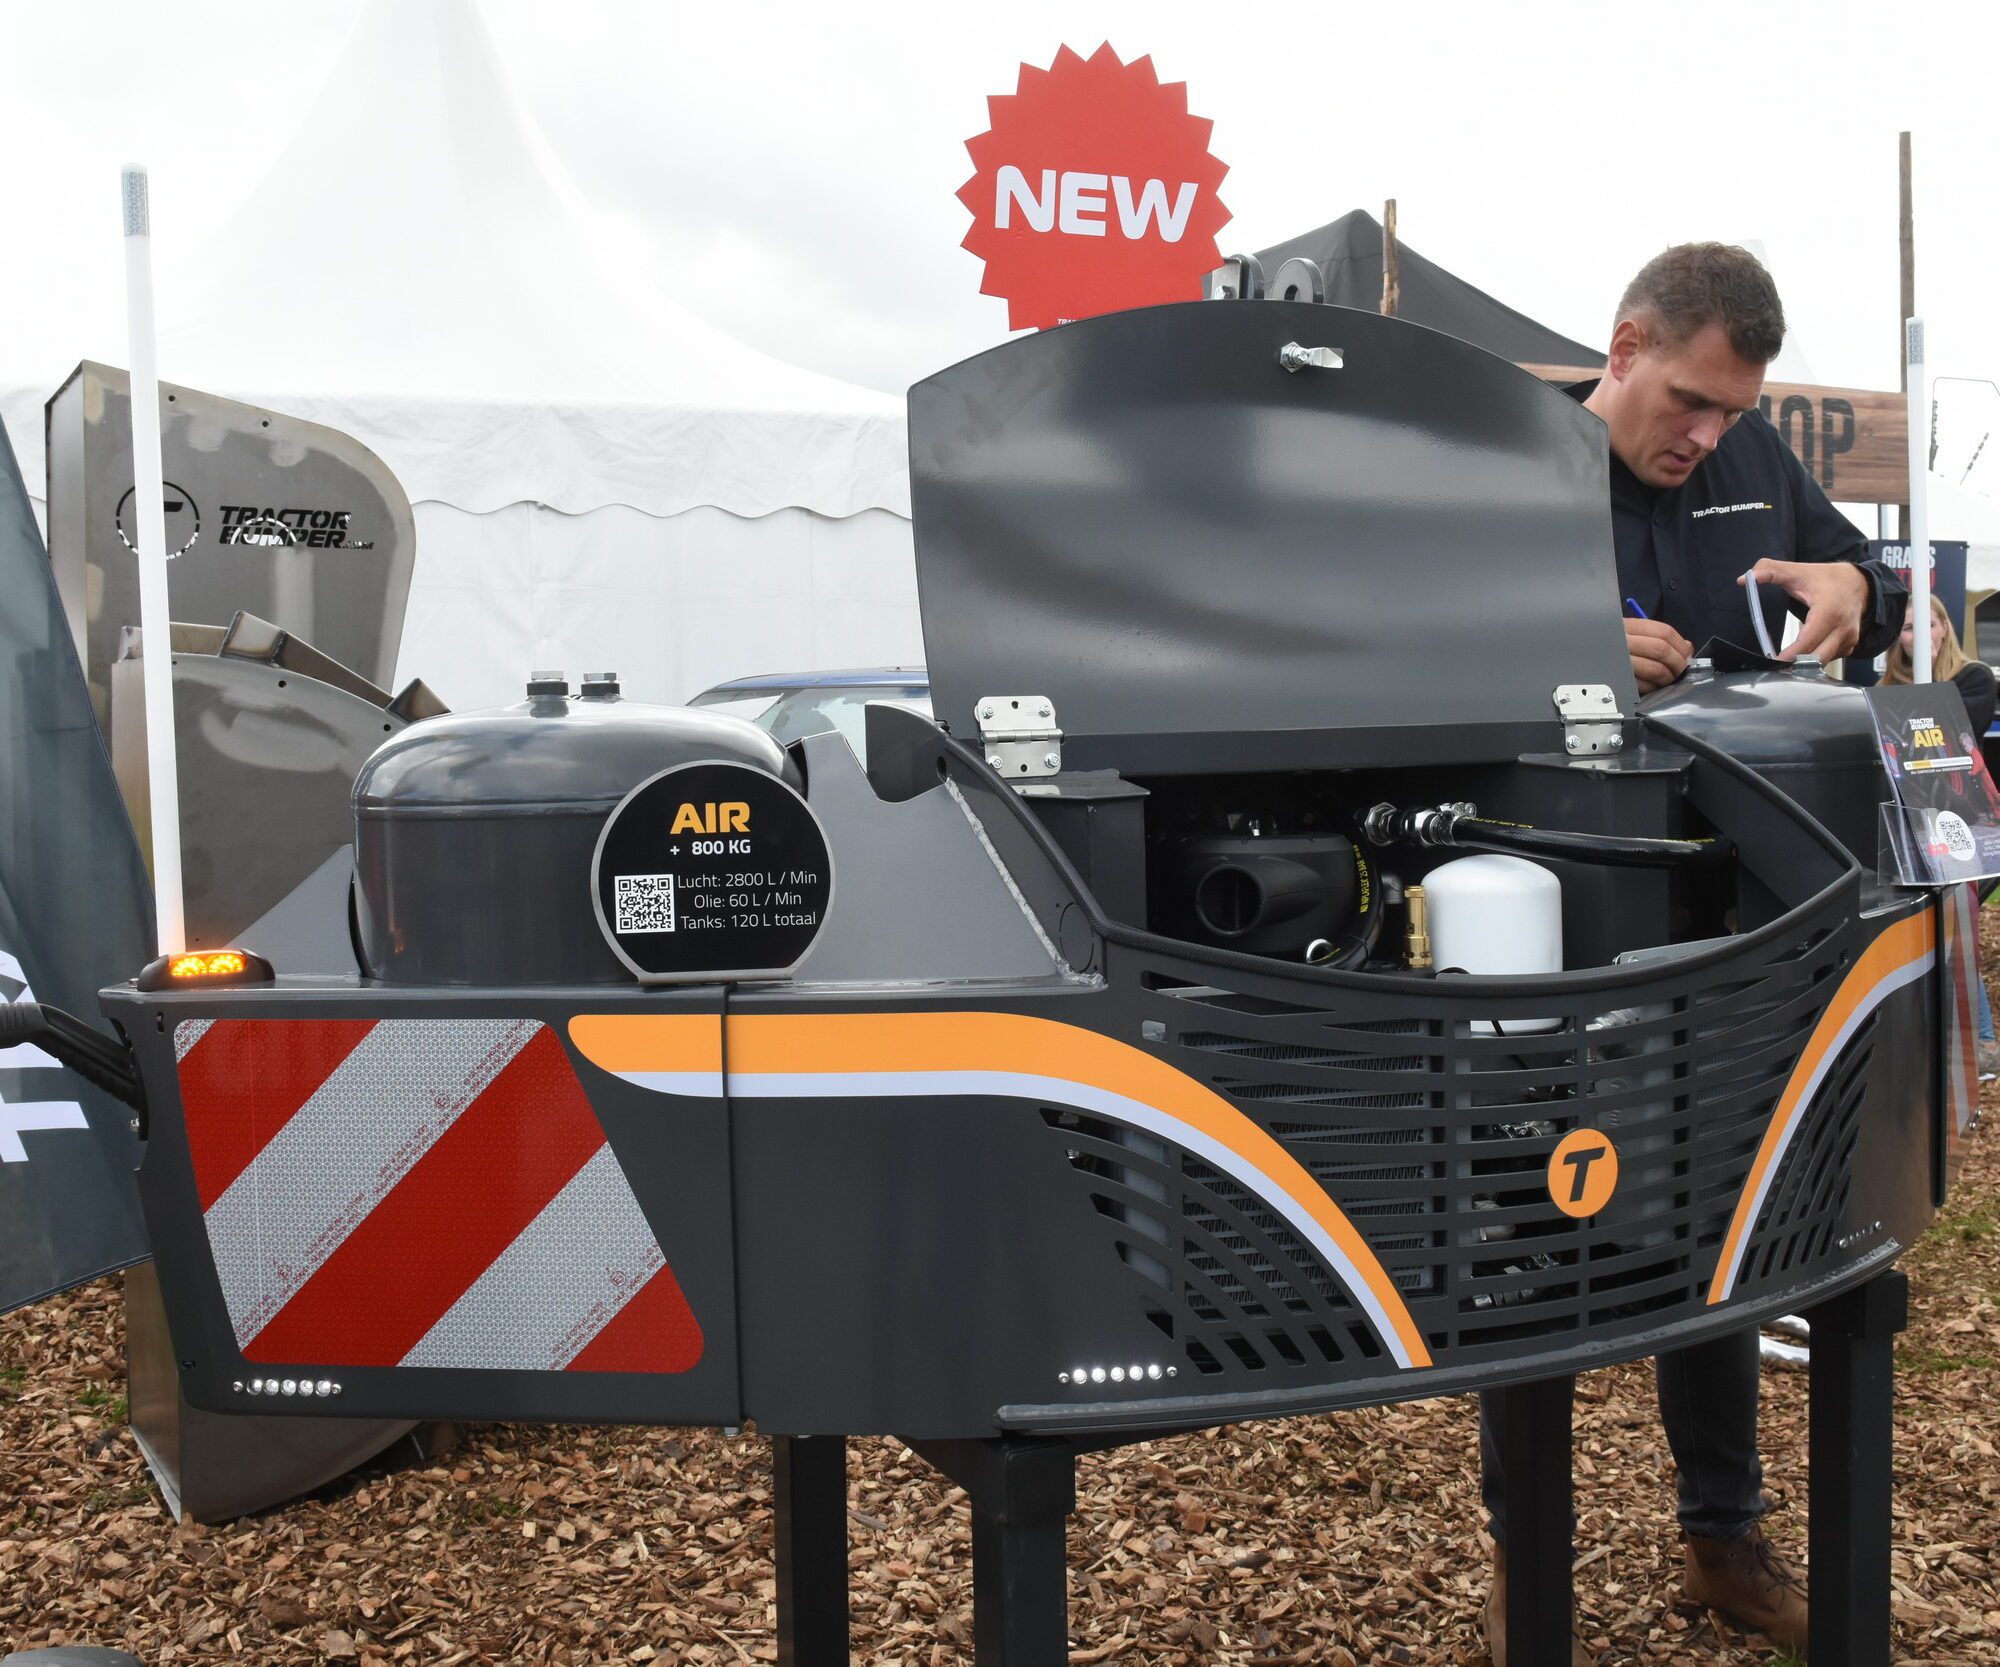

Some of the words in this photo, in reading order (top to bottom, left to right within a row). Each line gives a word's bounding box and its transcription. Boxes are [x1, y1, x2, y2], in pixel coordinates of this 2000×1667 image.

[994, 165, 1200, 243] NEW
[219, 506, 351, 530] TRACTOR
[1692, 506, 1731, 518] TRACTOR
[1882, 546, 1936, 569] GRAS
[1914, 728, 1945, 748] AIR
[670, 802, 751, 834] AIR
[691, 840, 725, 855] 800
[728, 839, 751, 854] KG
[677, 874, 721, 889] Lucht:
[725, 873, 764, 887] 2800
[767, 872, 776, 886] L
[779, 872, 786, 885] /
[790, 871, 817, 885] Min
[694, 894, 725, 909] Olie:
[729, 894, 749, 907] 60
[752, 893, 761, 907] L
[764, 893, 771, 906] /
[775, 892, 802, 906] Min
[680, 914, 726, 929] Tanks:
[731, 914, 759, 928] 120
[763, 913, 771, 927] L
[774, 911, 816, 926] totaal
[1563, 1146, 1606, 1203] T
